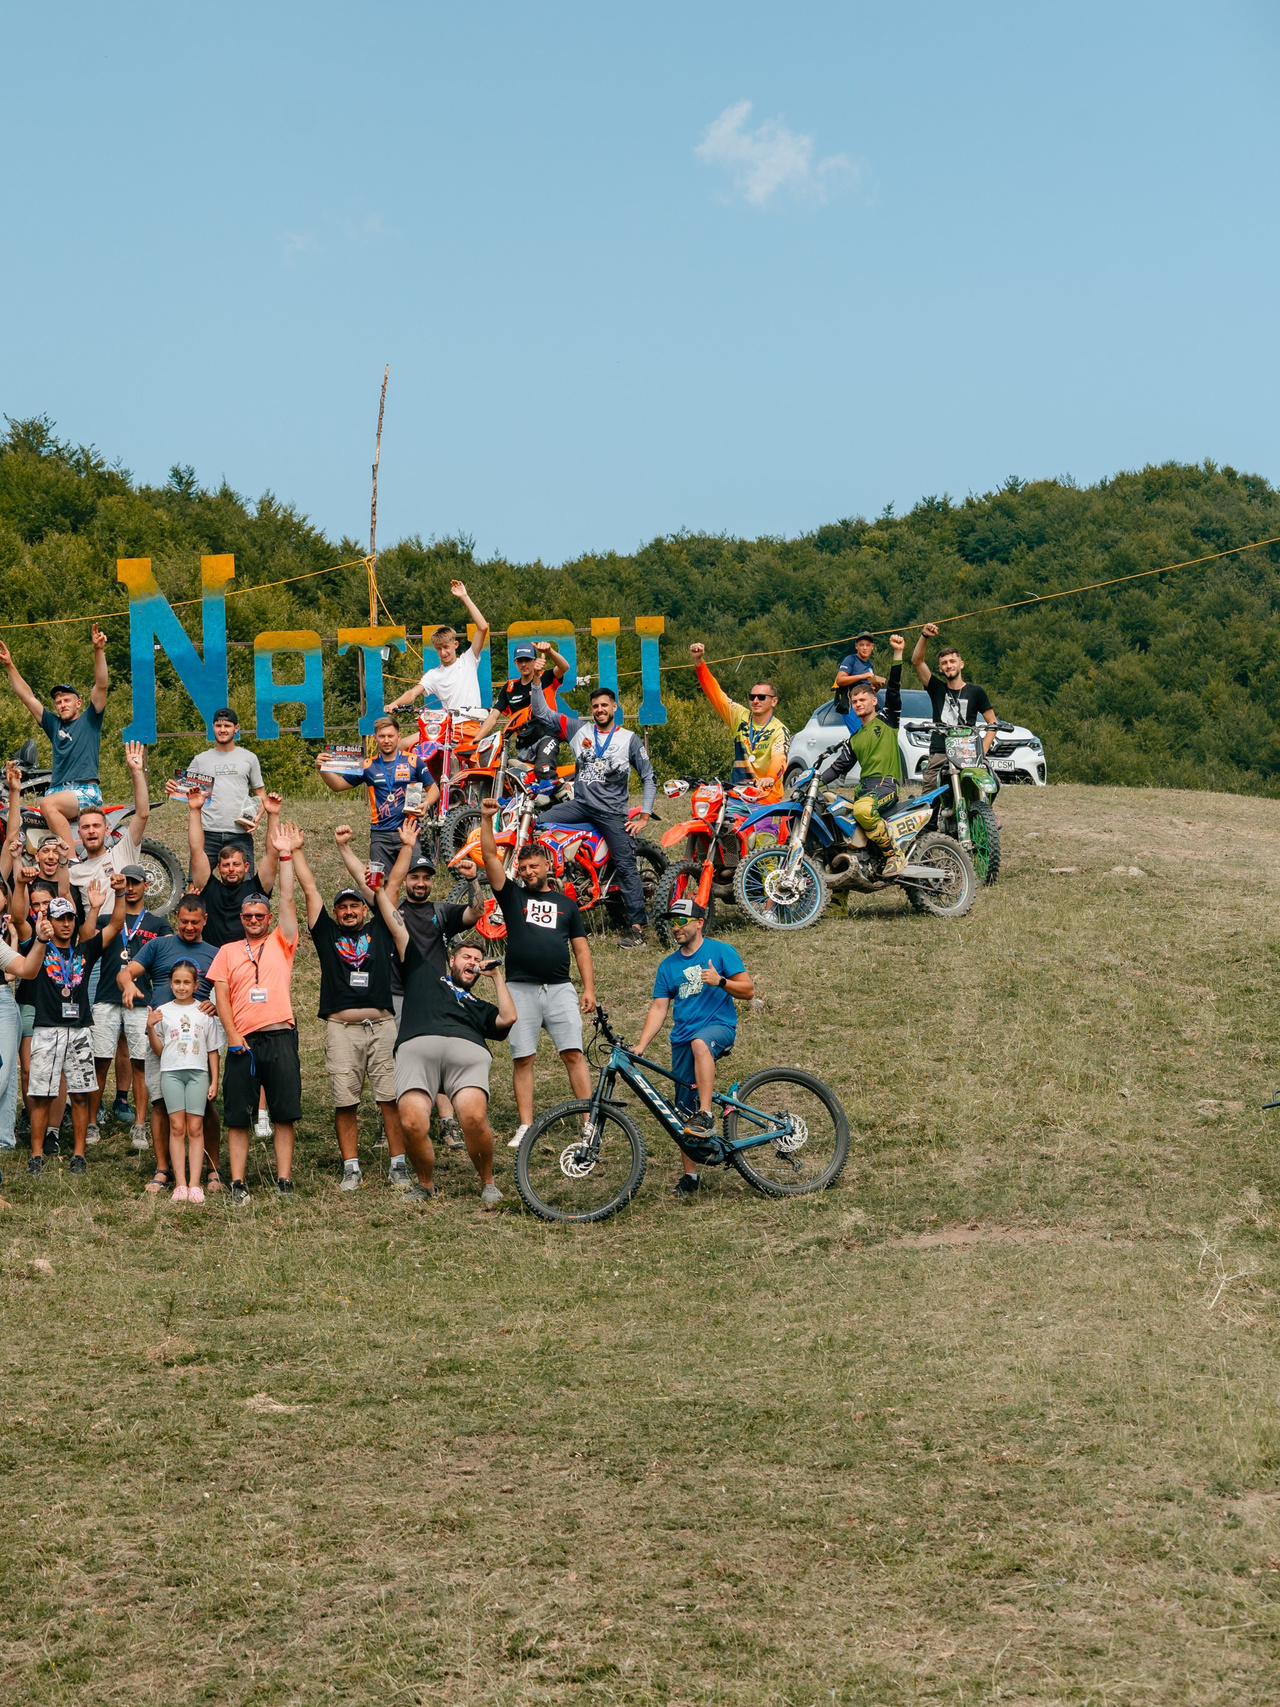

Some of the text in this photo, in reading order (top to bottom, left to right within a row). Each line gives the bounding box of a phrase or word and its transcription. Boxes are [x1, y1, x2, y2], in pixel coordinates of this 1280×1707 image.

[543, 739, 557, 755] SHOT
[214, 763, 237, 773] EA7
[997, 761, 1013, 770] CSM
[896, 820, 915, 835] 26
